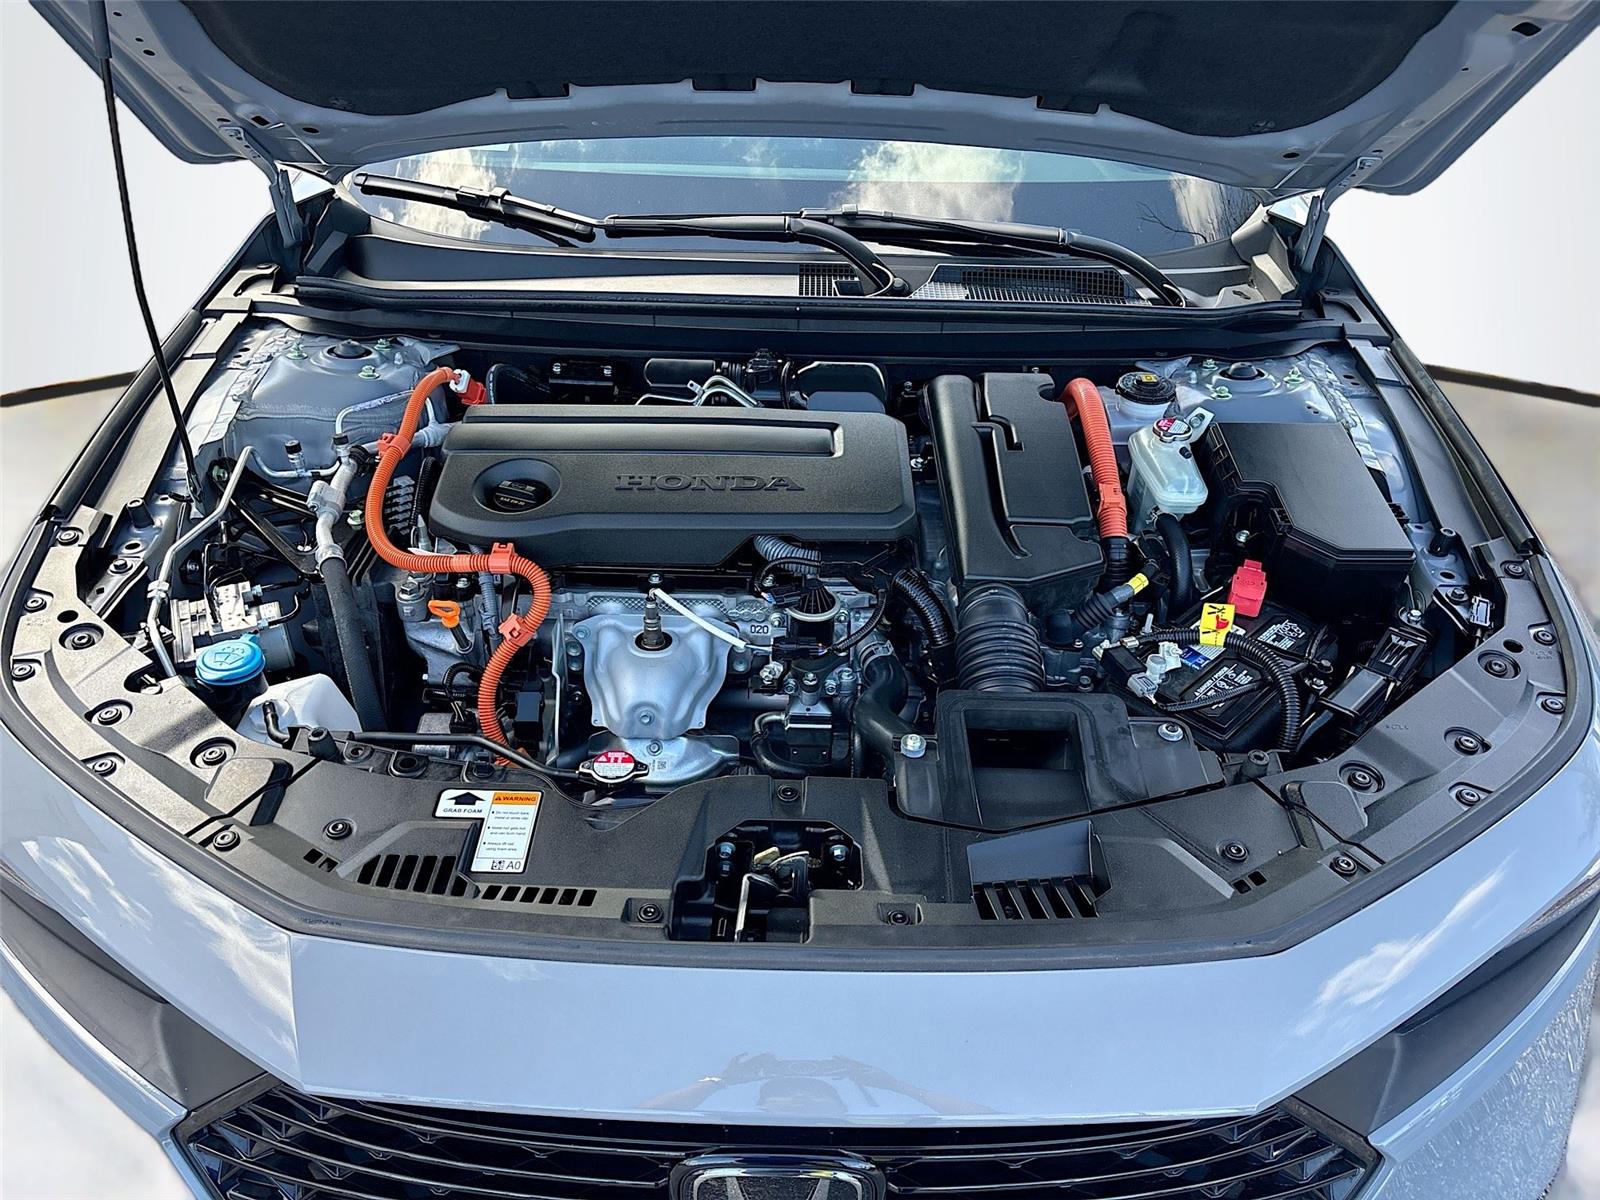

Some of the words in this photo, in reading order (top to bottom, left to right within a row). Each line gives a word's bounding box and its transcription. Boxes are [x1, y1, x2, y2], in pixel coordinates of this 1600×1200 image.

[614, 473, 805, 491] HONDA
[750, 624, 769, 634] 020
[506, 861, 521, 870] A0
